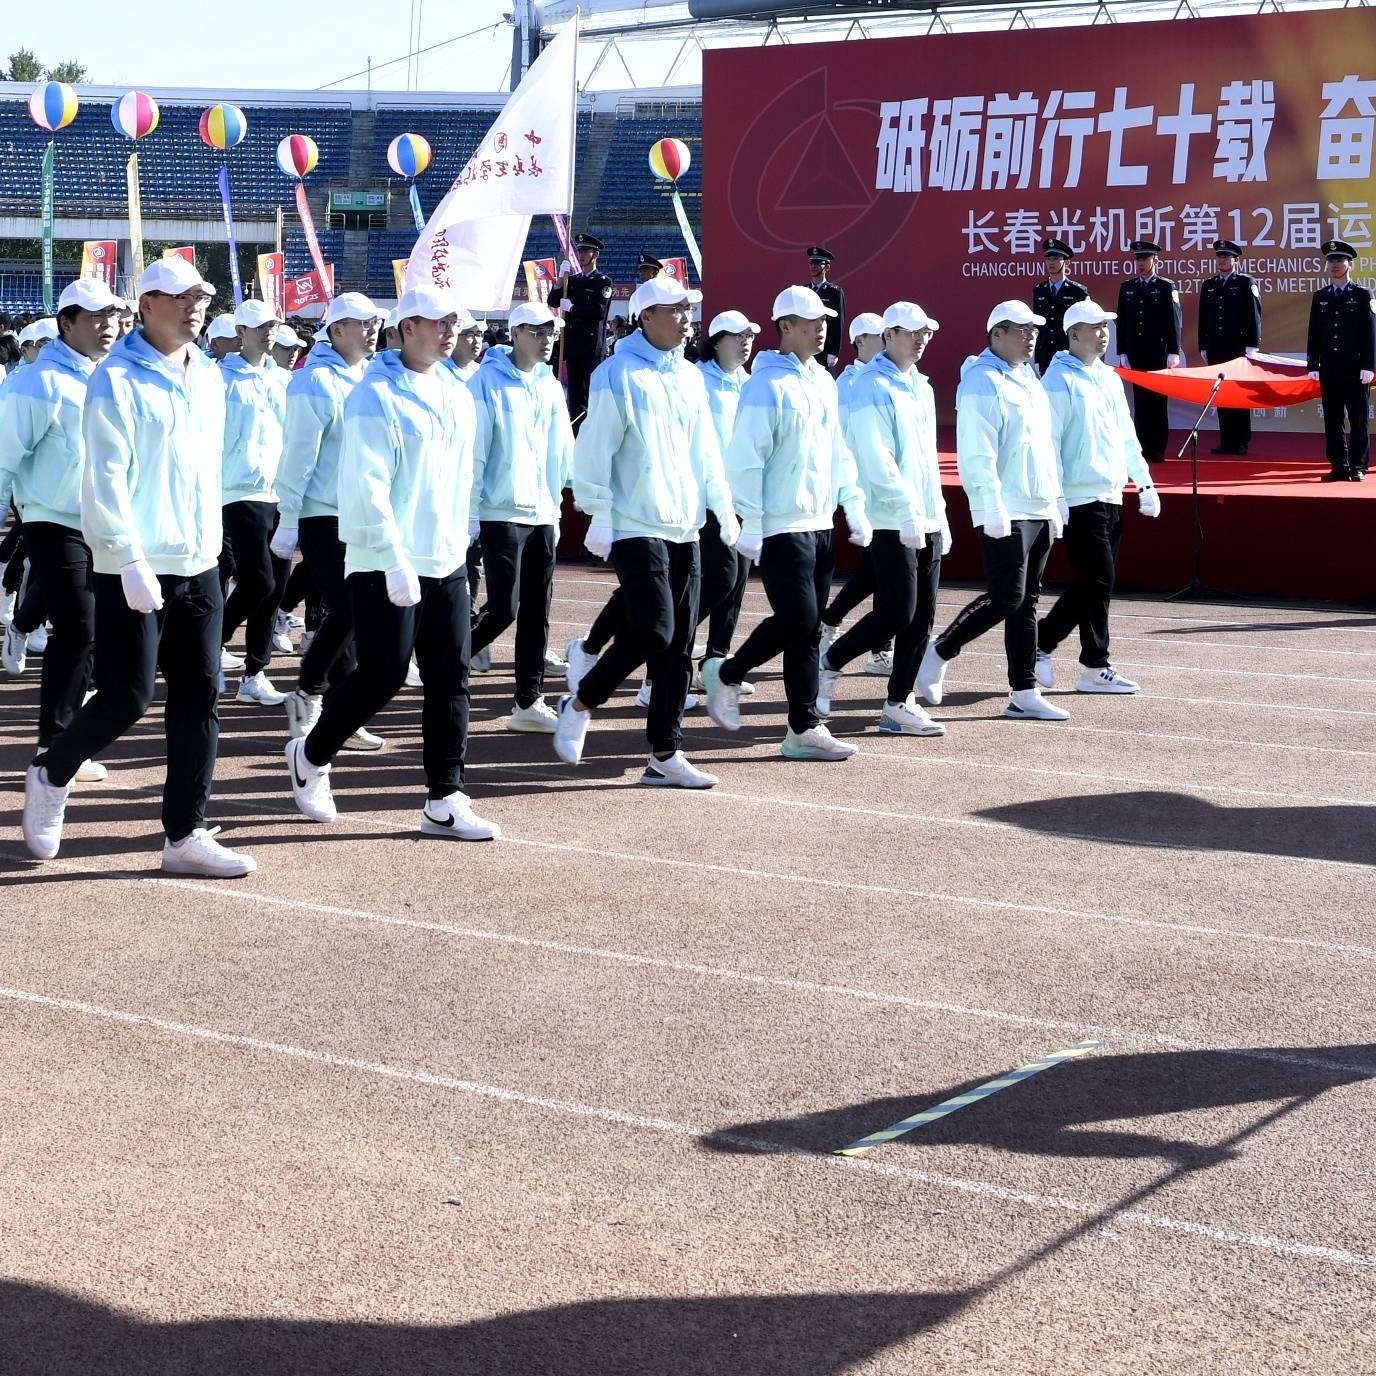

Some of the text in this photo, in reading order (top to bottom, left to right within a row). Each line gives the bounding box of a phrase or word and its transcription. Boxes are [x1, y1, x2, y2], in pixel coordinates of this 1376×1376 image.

[875, 79, 1276, 193] 砥砺前行七十载
[962, 261, 1045, 277] CHANGCHUN
[1065, 260, 1119, 276] STITUTE
[1277, 277, 1331, 293] MEETIN
